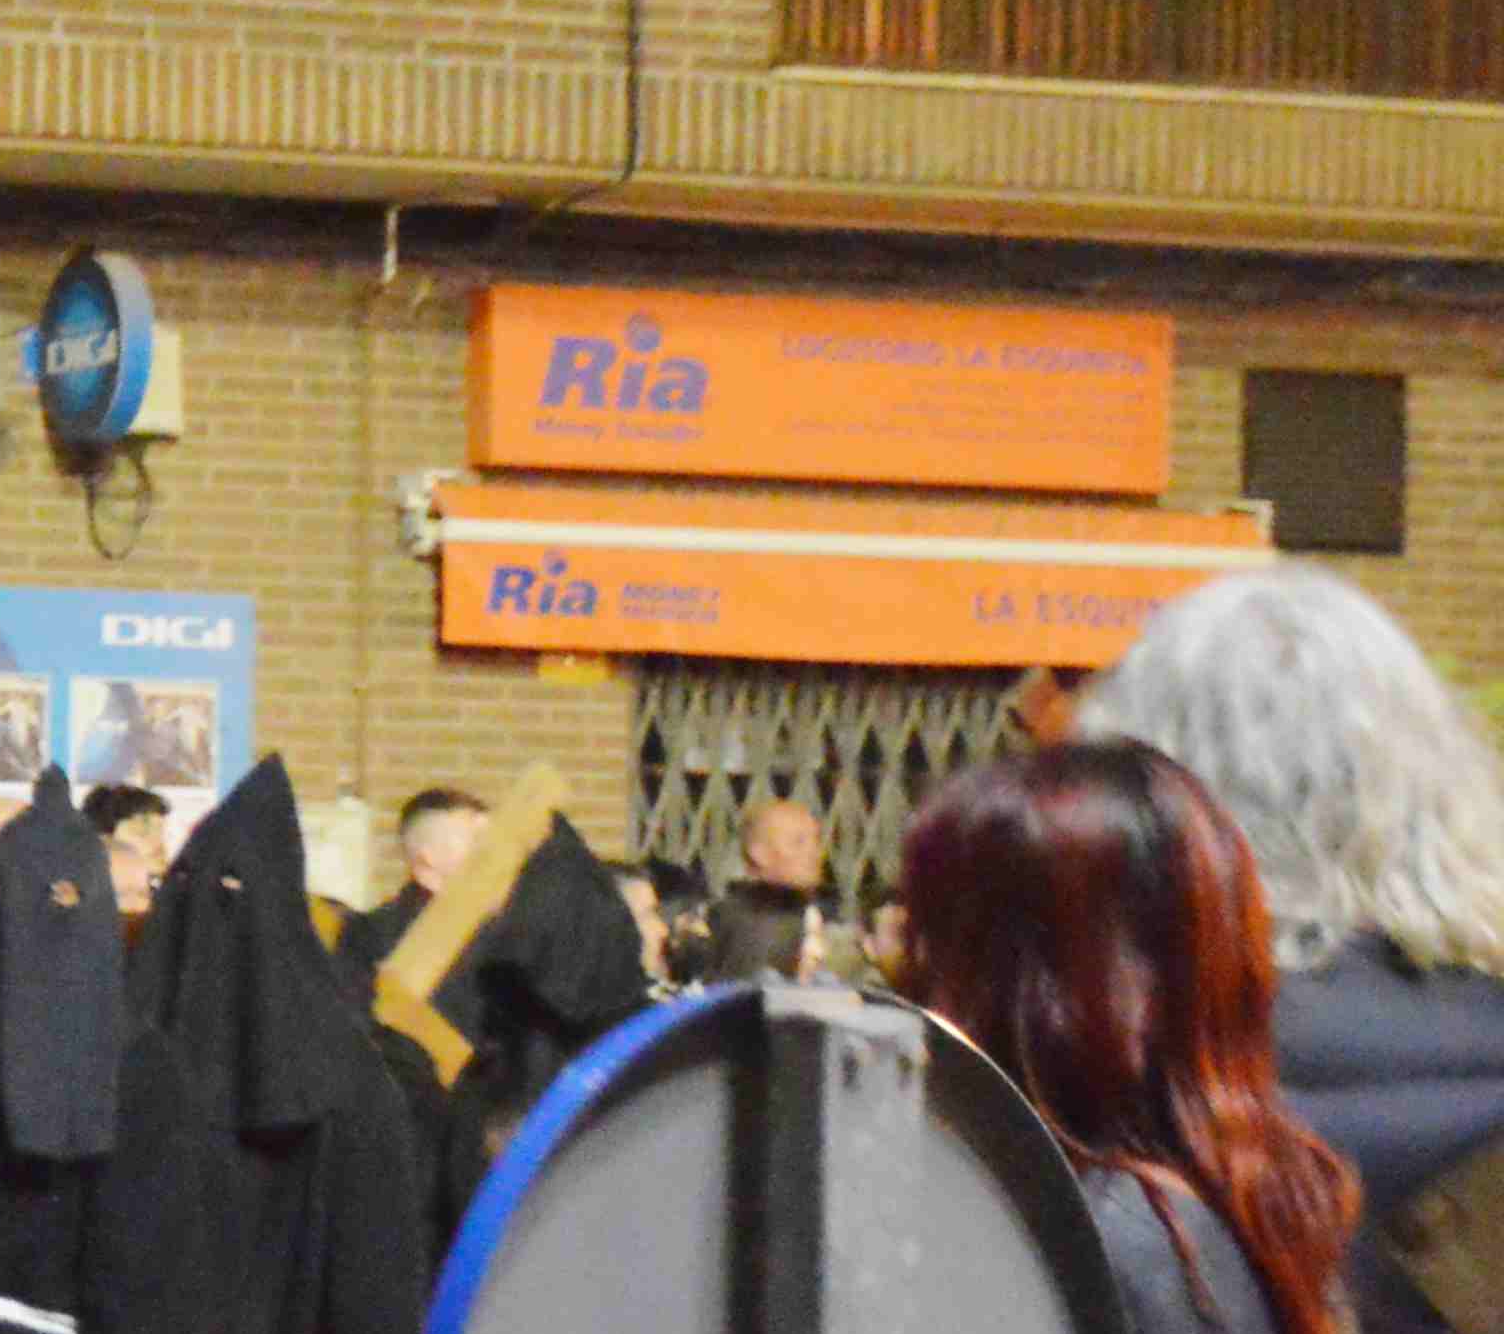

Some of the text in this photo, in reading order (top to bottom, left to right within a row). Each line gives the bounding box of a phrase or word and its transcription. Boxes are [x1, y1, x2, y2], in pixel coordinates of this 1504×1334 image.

[541, 313, 710, 413] Ria
[486, 548, 599, 616] Ria
[974, 592, 1016, 622] LA
[101, 613, 235, 651] DIGI
